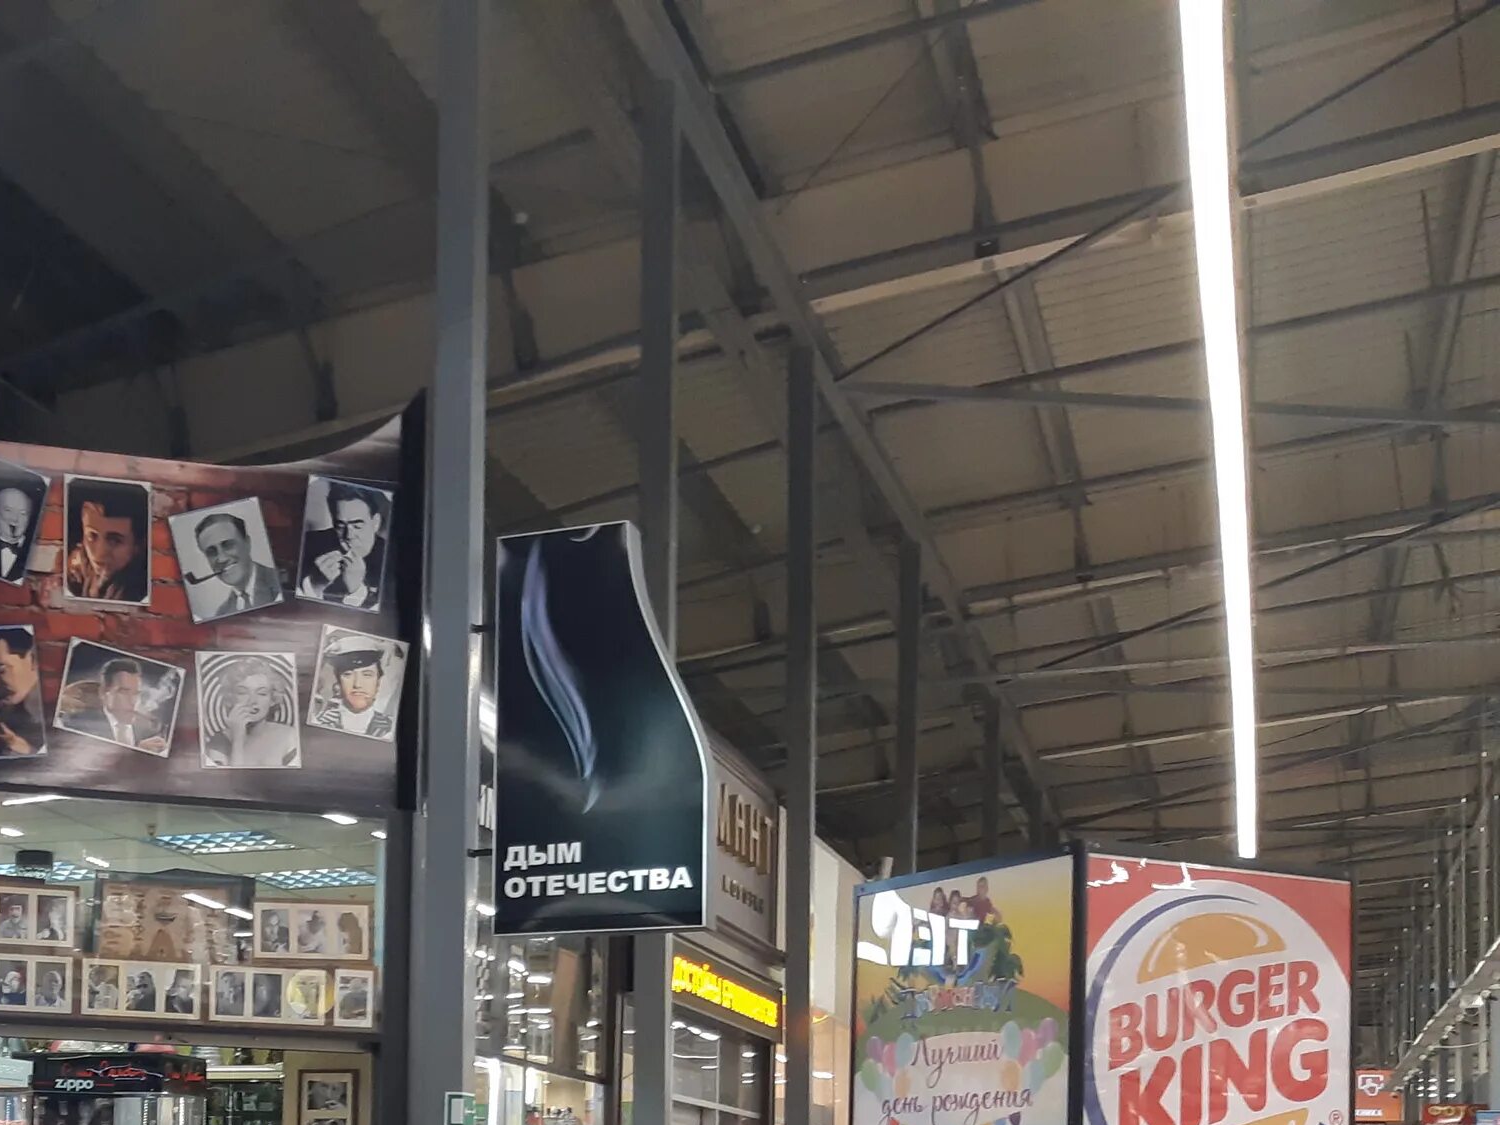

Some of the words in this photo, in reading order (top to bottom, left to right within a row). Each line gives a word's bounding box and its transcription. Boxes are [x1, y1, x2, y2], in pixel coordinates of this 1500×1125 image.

[503, 841, 583, 872] ДЫМ
[503, 866, 694, 899] ОТЕЧЕСТВА
[1108, 959, 1320, 1071] BURGER
